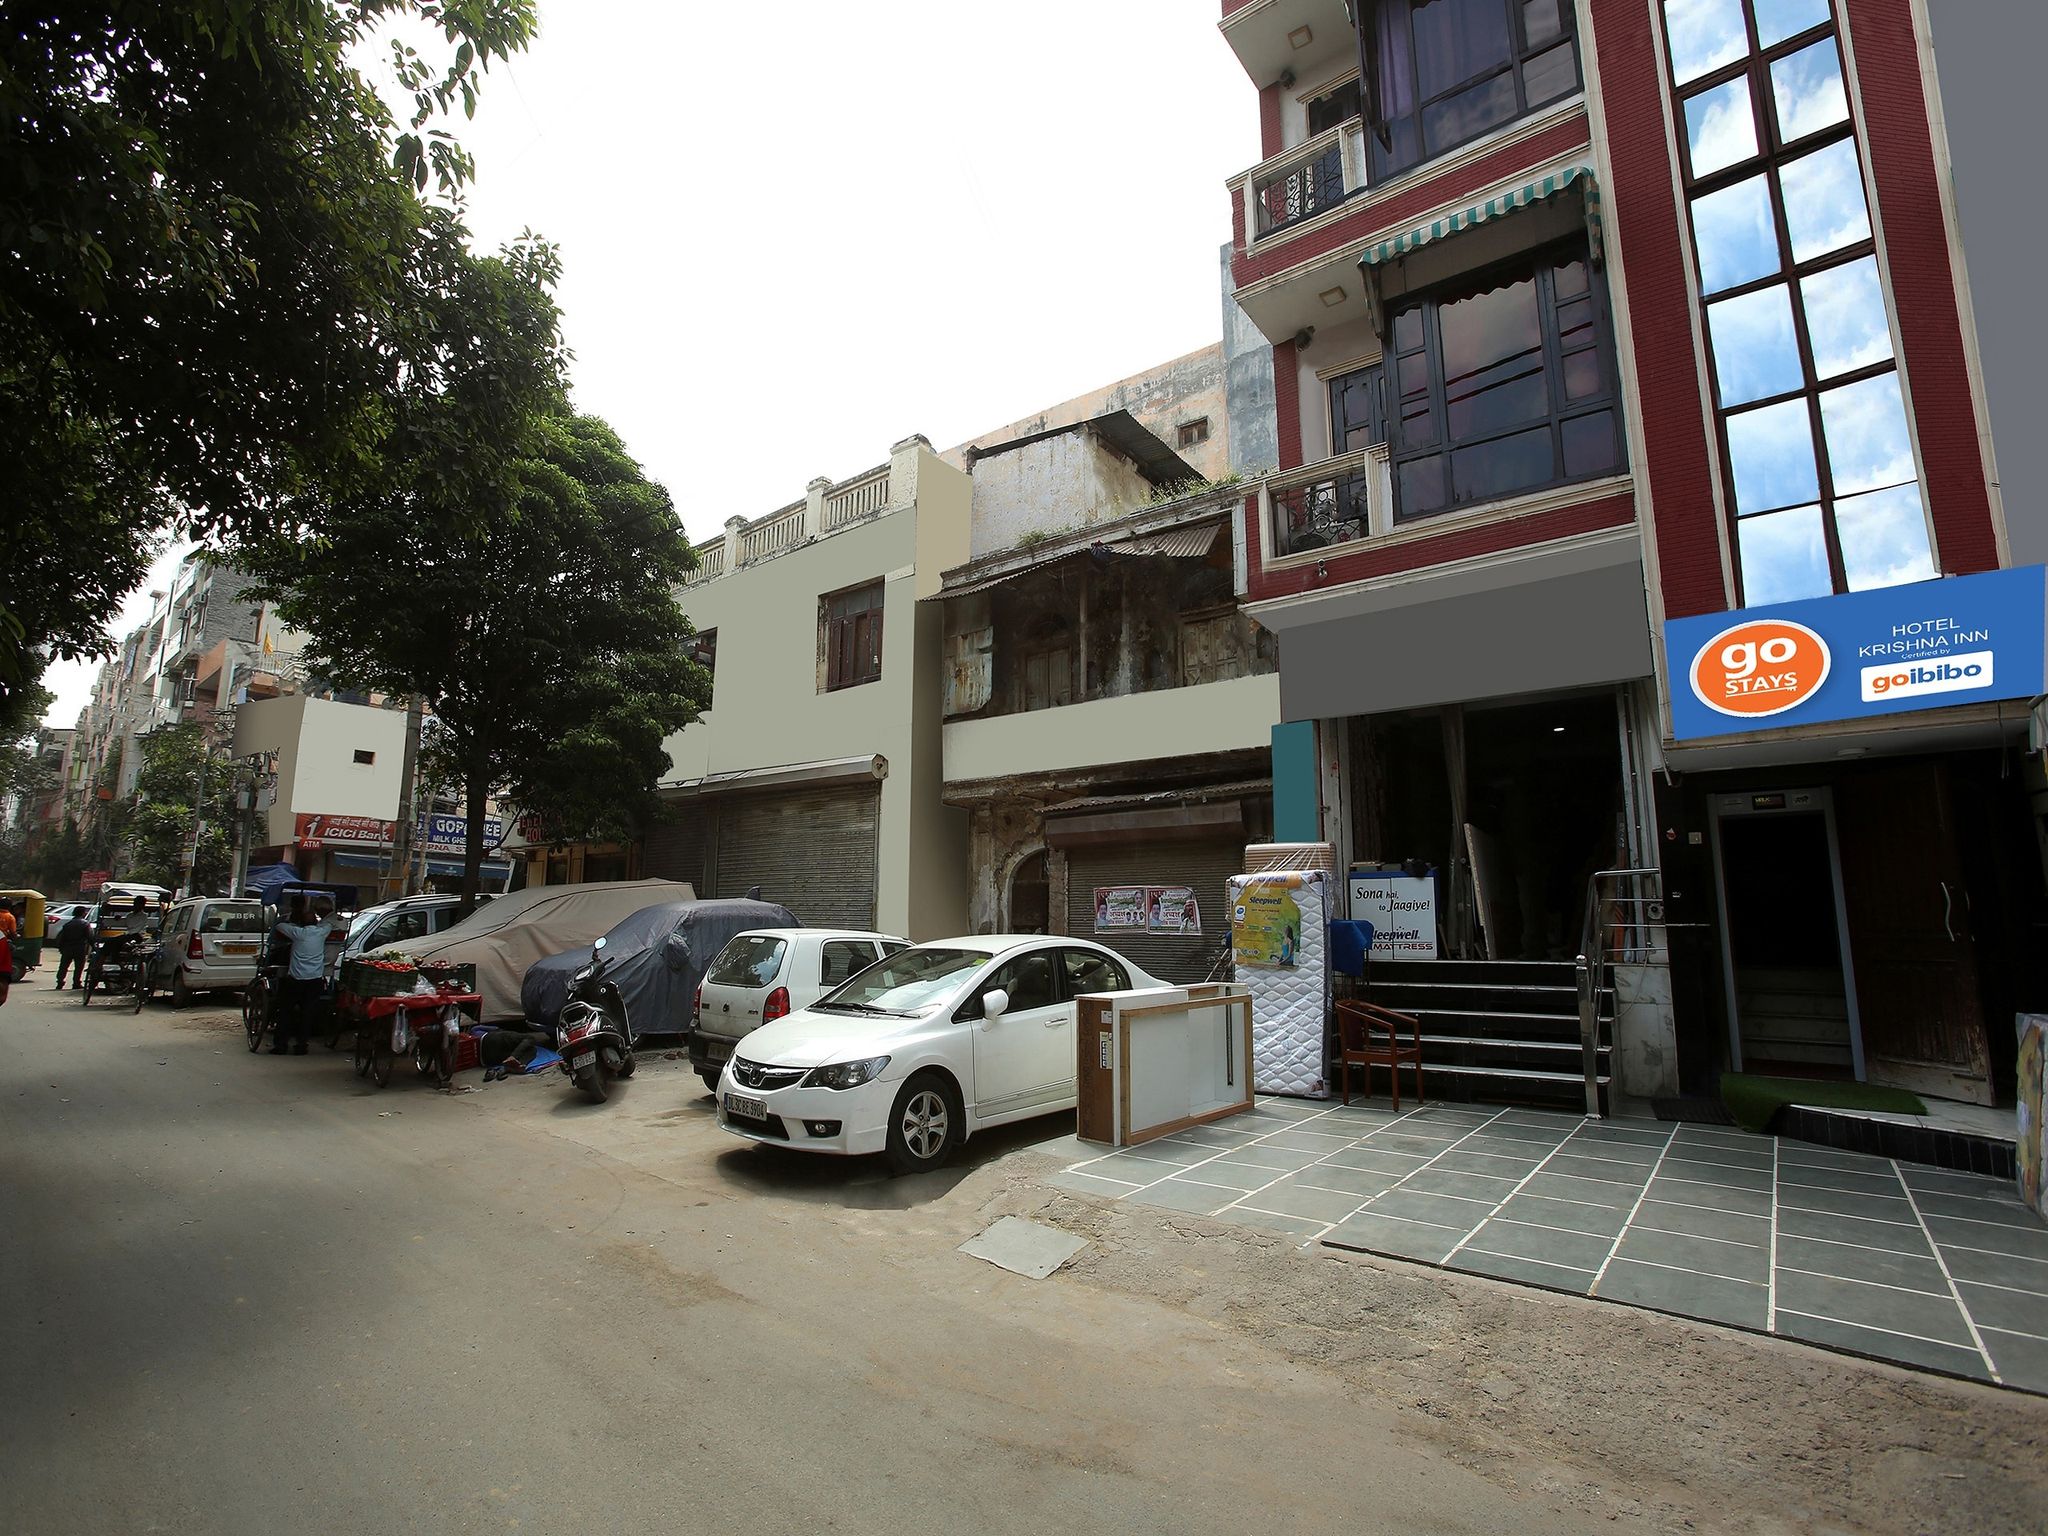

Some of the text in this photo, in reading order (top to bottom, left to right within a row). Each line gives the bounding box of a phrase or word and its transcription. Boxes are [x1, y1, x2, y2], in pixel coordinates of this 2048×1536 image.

[1892, 618, 1960, 637] HOTEL
[1859, 629, 1989, 658] KRISHNA INN
[1720, 637, 1798, 680] go
[1725, 672, 1798, 695] STAYS
[1872, 664, 1982, 693] goibibo
[357, 830, 390, 840] Bank
[432, 835, 450, 843] MILK
[1355, 887, 1399, 899] Sona hai,
[1249, 896, 1282, 905] Sleepwell
[1387, 900, 1430, 912] Jaagiye!
[1373, 929, 1419, 941] leepwell
[1373, 943, 1433, 951] MATTRESS
